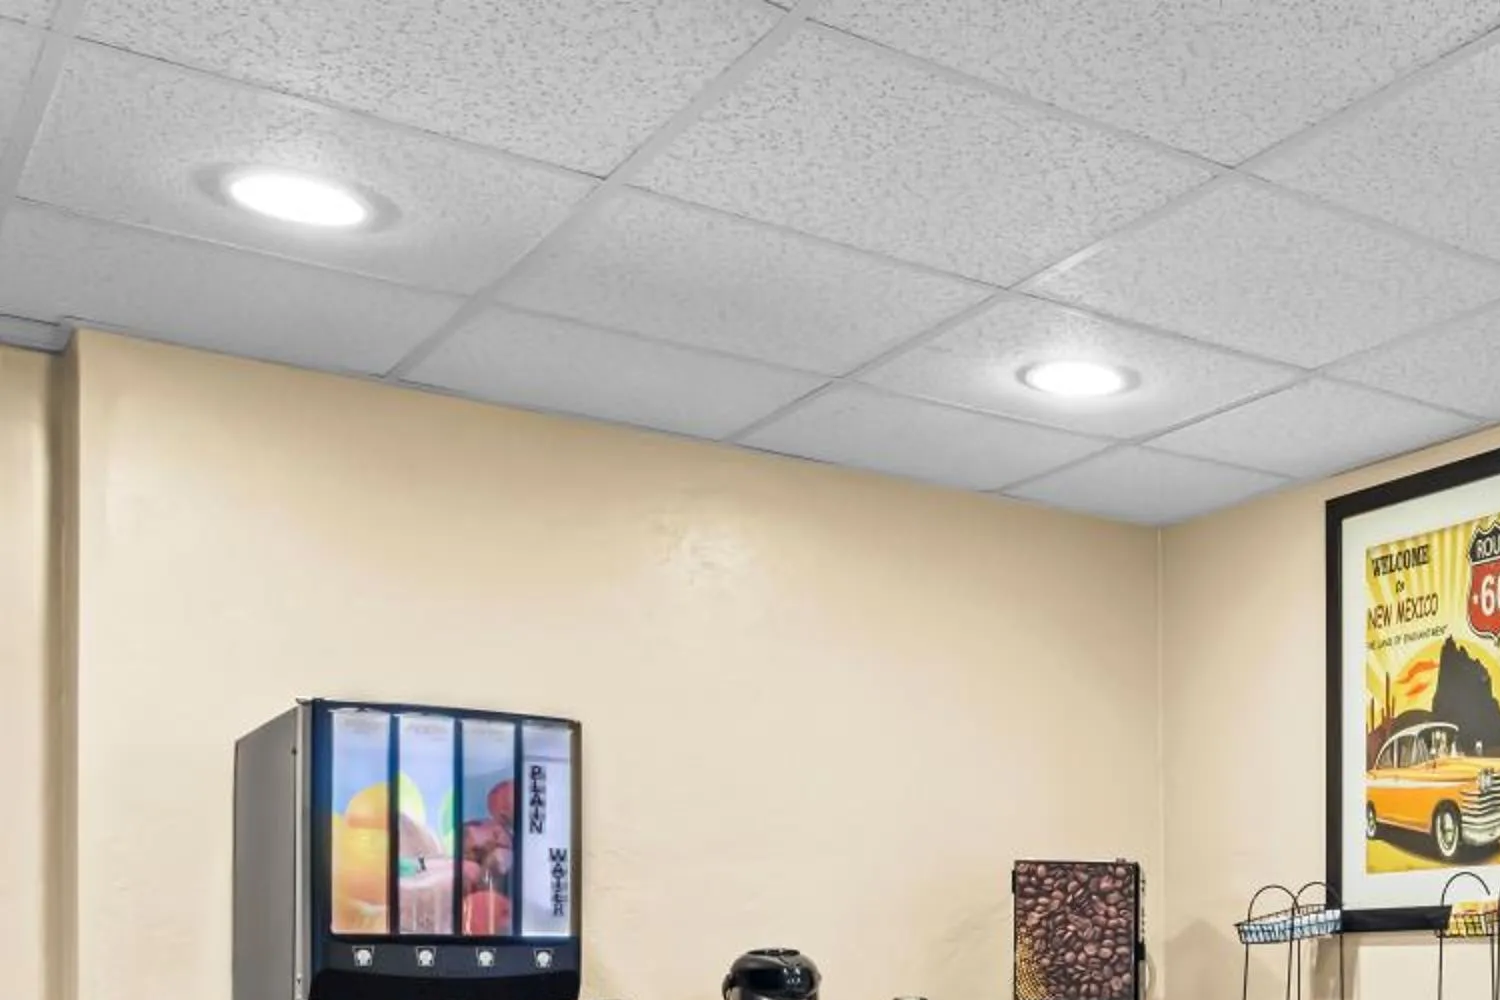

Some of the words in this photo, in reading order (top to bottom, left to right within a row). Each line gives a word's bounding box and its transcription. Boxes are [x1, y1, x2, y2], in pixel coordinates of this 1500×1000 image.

[1371, 544, 1429, 577] WELCOME
[1367, 602, 1392, 629] NEW
[1396, 592, 1439, 624] MEXICO
[529, 765, 545, 834] PLAIN
[550, 848, 567, 917] WATER
